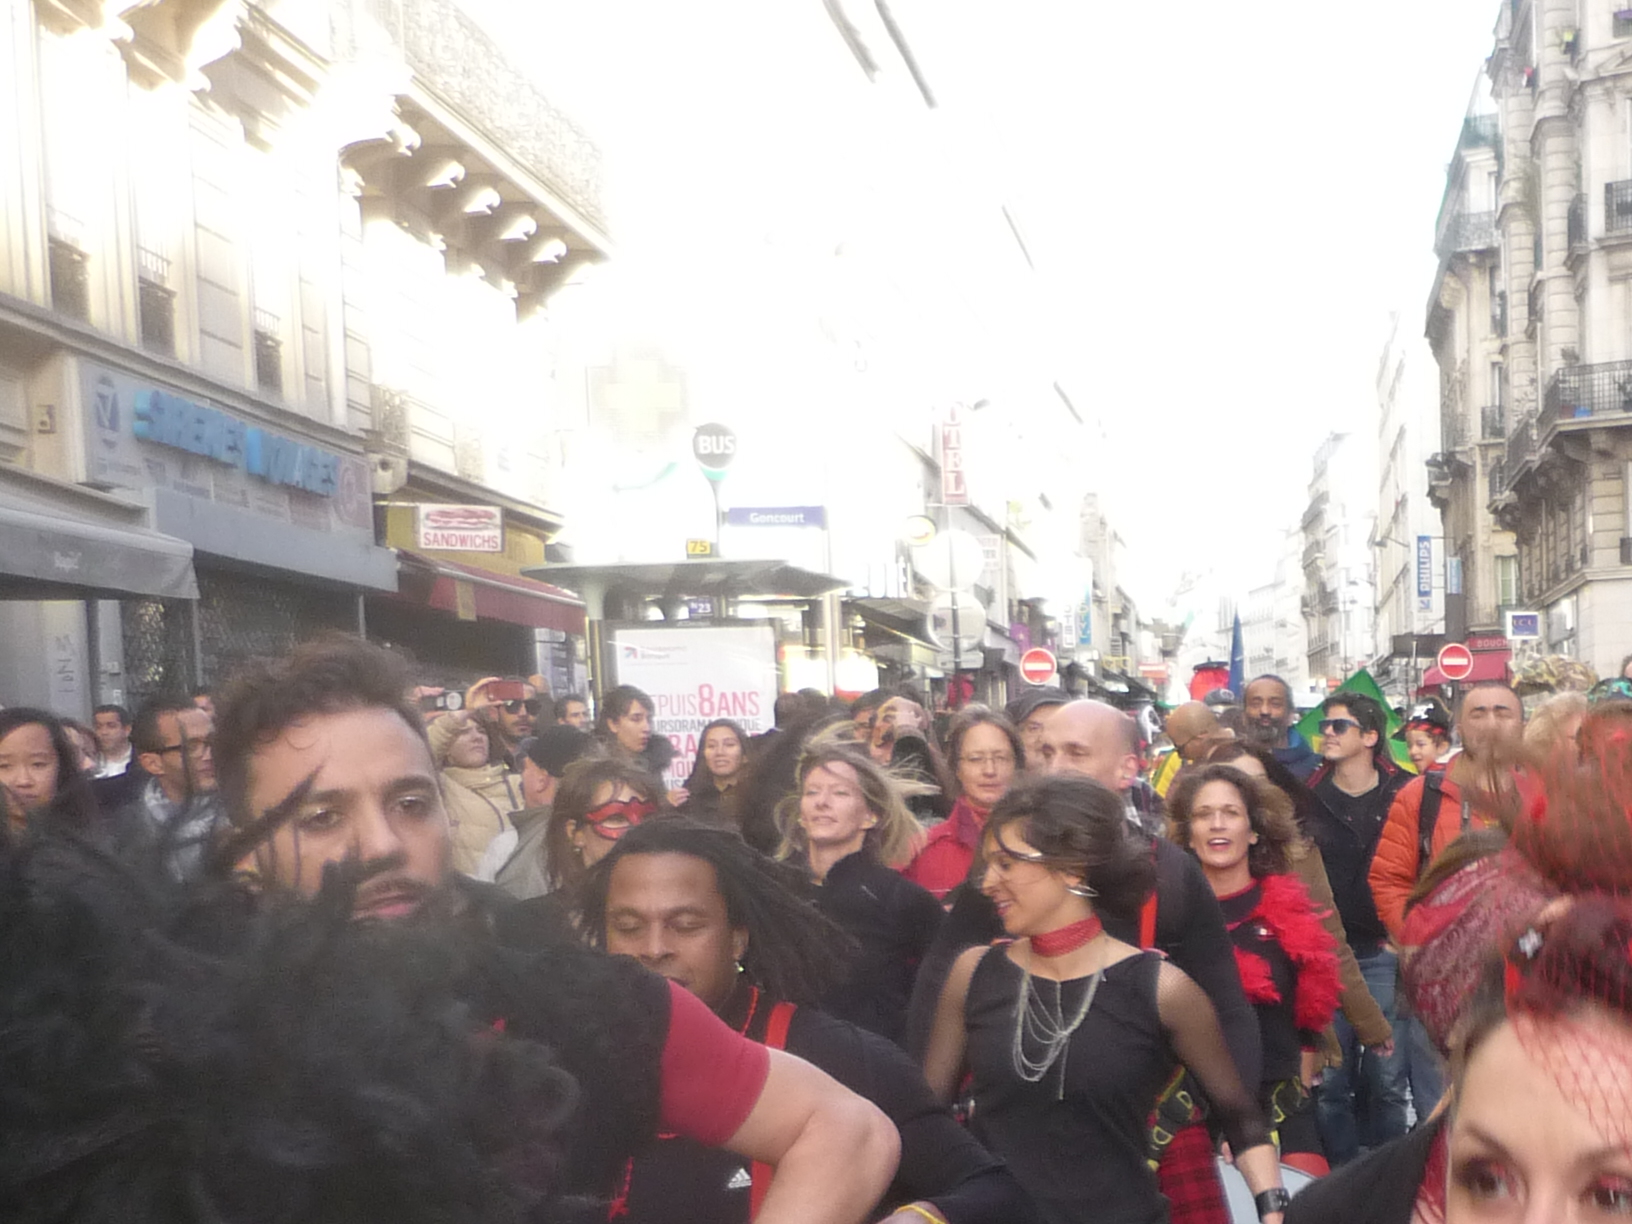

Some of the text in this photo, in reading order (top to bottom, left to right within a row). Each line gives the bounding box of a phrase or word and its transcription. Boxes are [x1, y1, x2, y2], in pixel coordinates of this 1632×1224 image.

[698, 434, 735, 454] BUS
[749, 512, 805, 523] Goncourt
[423, 532, 499, 549] SANDWICHS
[689, 541, 708, 552] 75
[1419, 541, 1431, 592] PHILIPS
[698, 602, 711, 613] 23
[698, 683, 715, 717] 8
[717, 690, 760, 717] ANS
